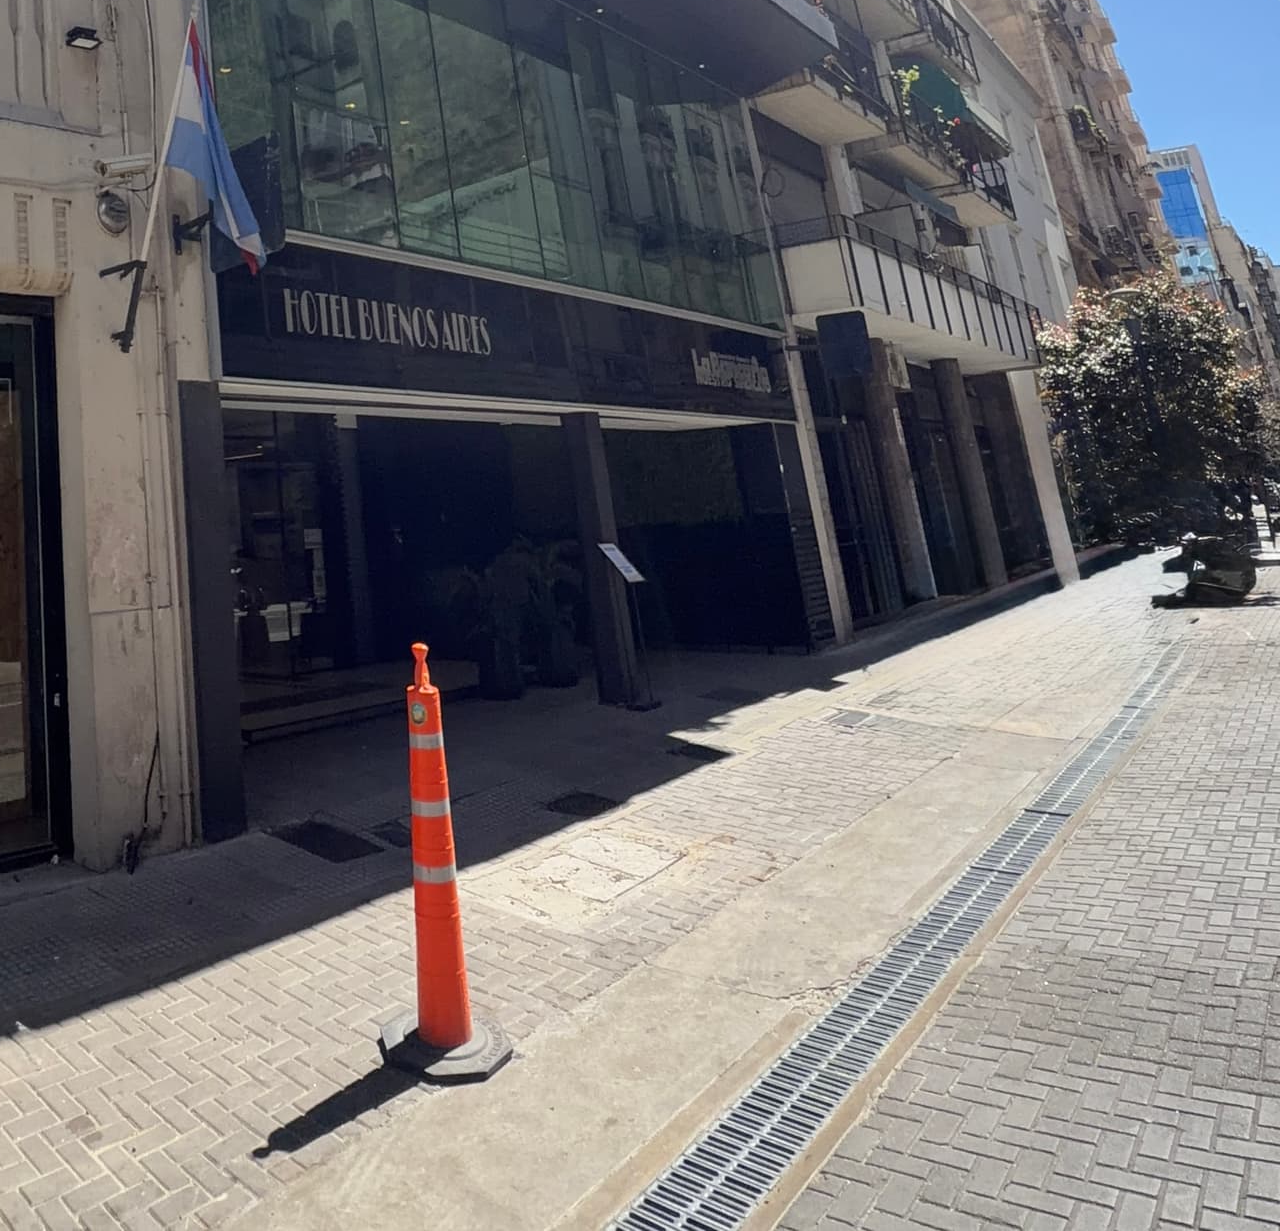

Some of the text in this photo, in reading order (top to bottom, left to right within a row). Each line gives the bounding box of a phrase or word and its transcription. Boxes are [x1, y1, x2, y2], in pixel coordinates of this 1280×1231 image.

[283, 288, 491, 356] HOTEL BUENOS AIRES
